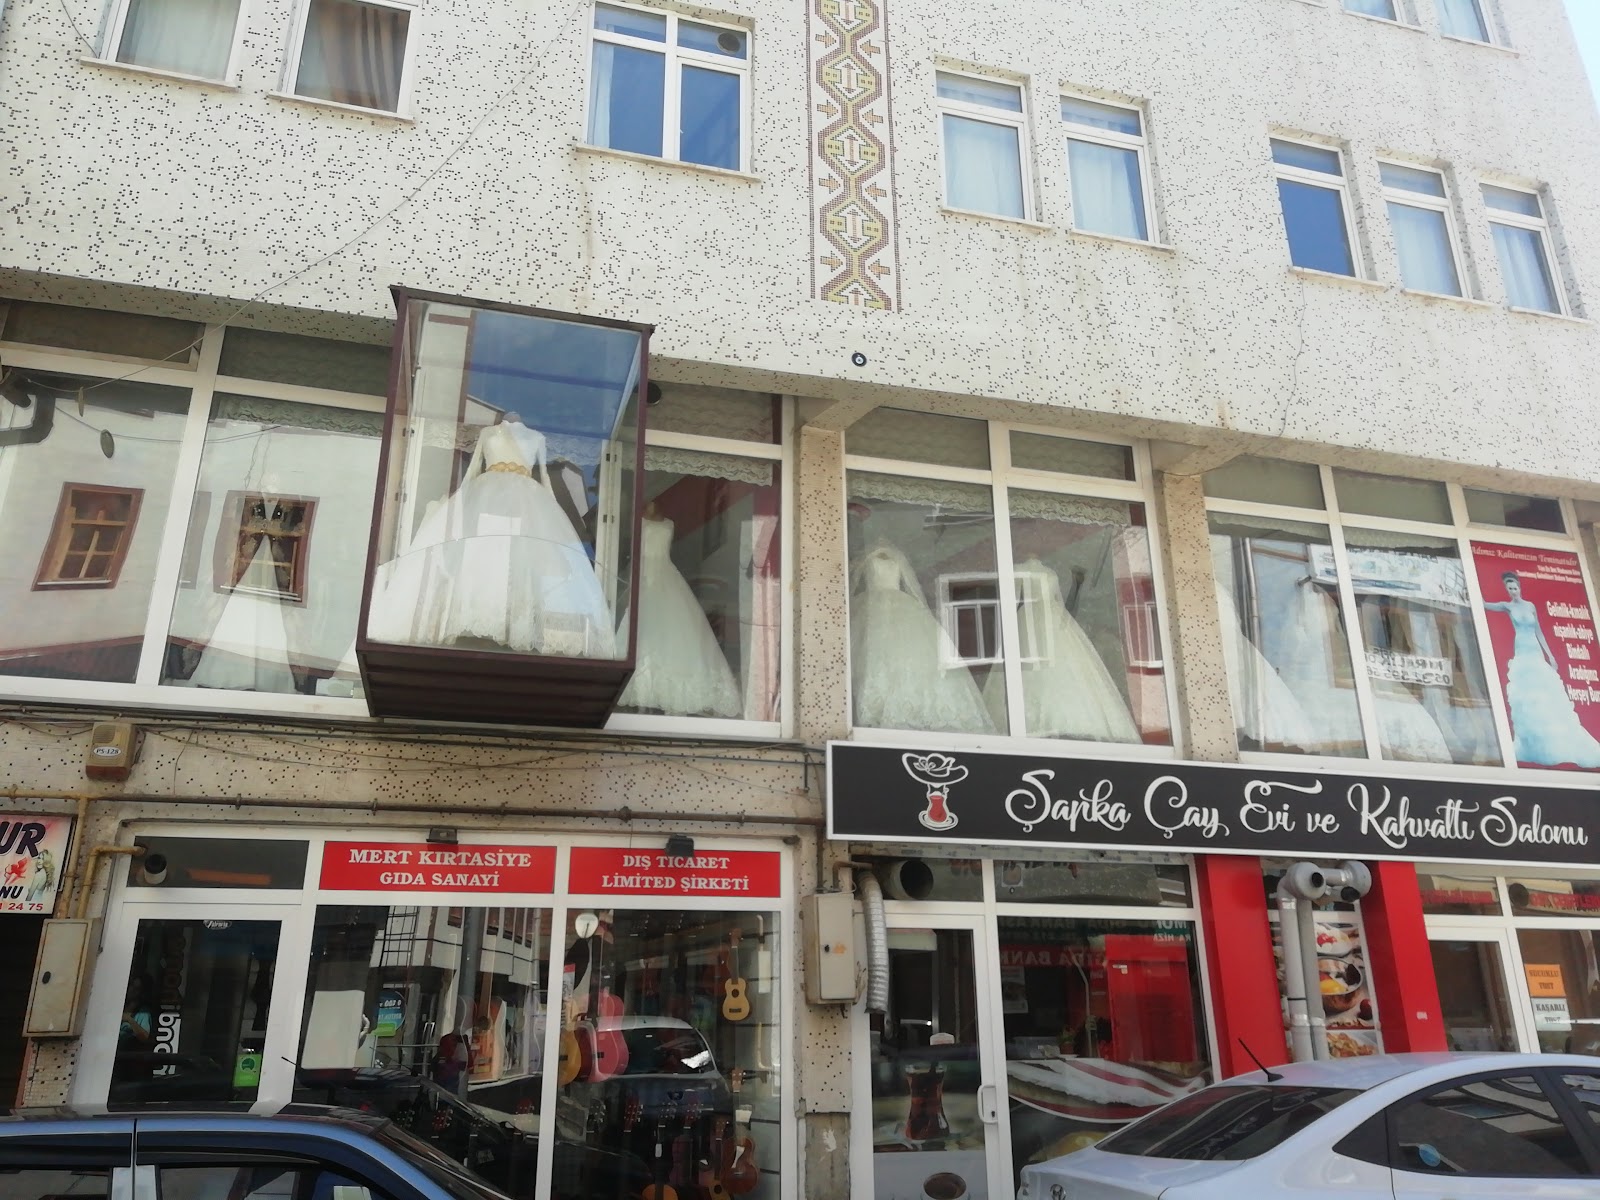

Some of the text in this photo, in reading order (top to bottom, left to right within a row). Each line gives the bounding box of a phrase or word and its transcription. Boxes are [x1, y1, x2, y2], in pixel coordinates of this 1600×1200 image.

[1005, 769, 1588, 849] Şapka Çay Evi ve Kahvaltı Salonu
[349, 849, 532, 867] MERT KIRTASİYE
[623, 855, 651, 870] DIŞ
[379, 871, 500, 886] GIDA SANAYİ
[602, 873, 749, 892] LİMİTED ŞİRKETİ
[8, 902, 43, 911] 24 75
